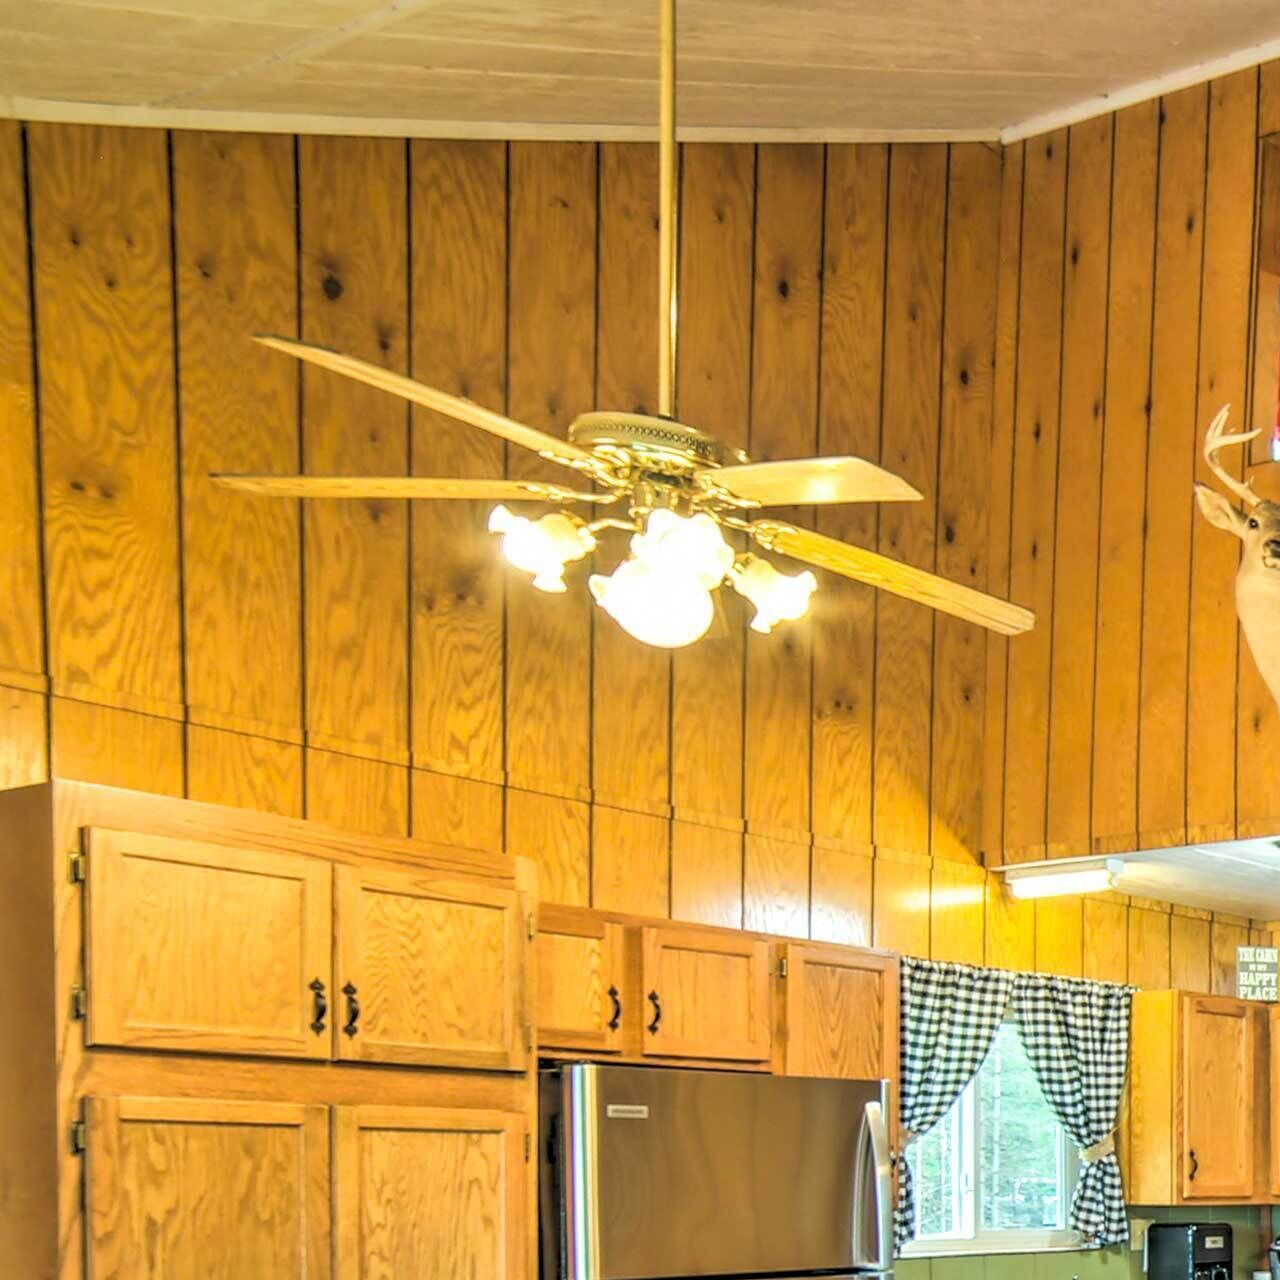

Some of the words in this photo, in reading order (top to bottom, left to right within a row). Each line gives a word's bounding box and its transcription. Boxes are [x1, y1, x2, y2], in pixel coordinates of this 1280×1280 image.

[1238, 947, 1255, 962] THE
[1239, 972, 1278, 986] HAPPY
[1239, 986, 1278, 1000] PLACE
